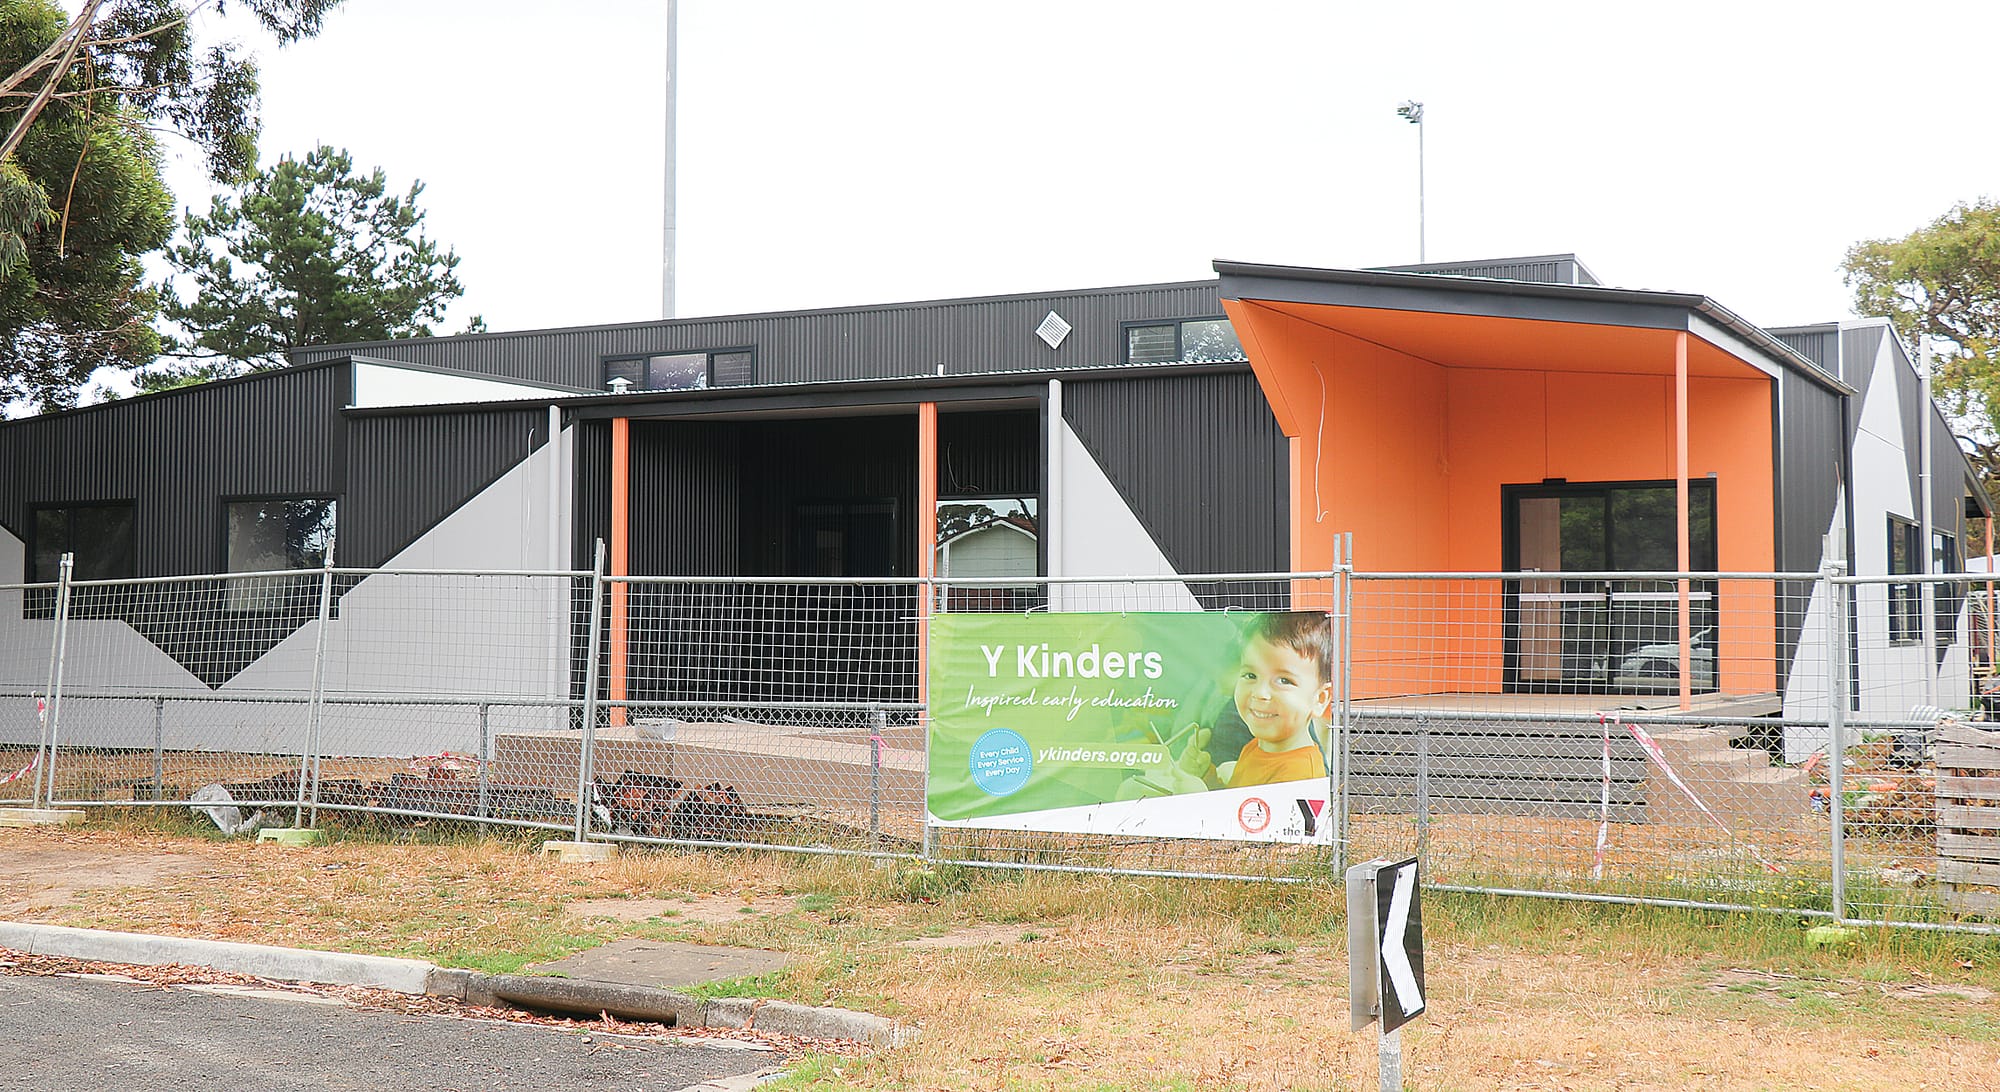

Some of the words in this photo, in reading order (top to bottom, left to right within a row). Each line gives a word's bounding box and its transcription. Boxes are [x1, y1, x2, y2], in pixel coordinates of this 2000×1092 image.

[980, 645, 1005, 678] Y
[1017, 643, 1163, 679] Kinders
[965, 684, 1038, 717] Inspired
[1042, 685, 1088, 721] early
[1091, 686, 1179, 709] education
[980, 750, 1000, 759] Every
[1000, 746, 1019, 756] Child
[1036, 747, 1163, 766] ykinders.org.au
[977, 760, 998, 769] Every
[998, 757, 1025, 766] Service
[985, 768, 1005, 777] Every
[1005, 766, 1021, 775] Day
[1282, 827, 1301, 836] the
